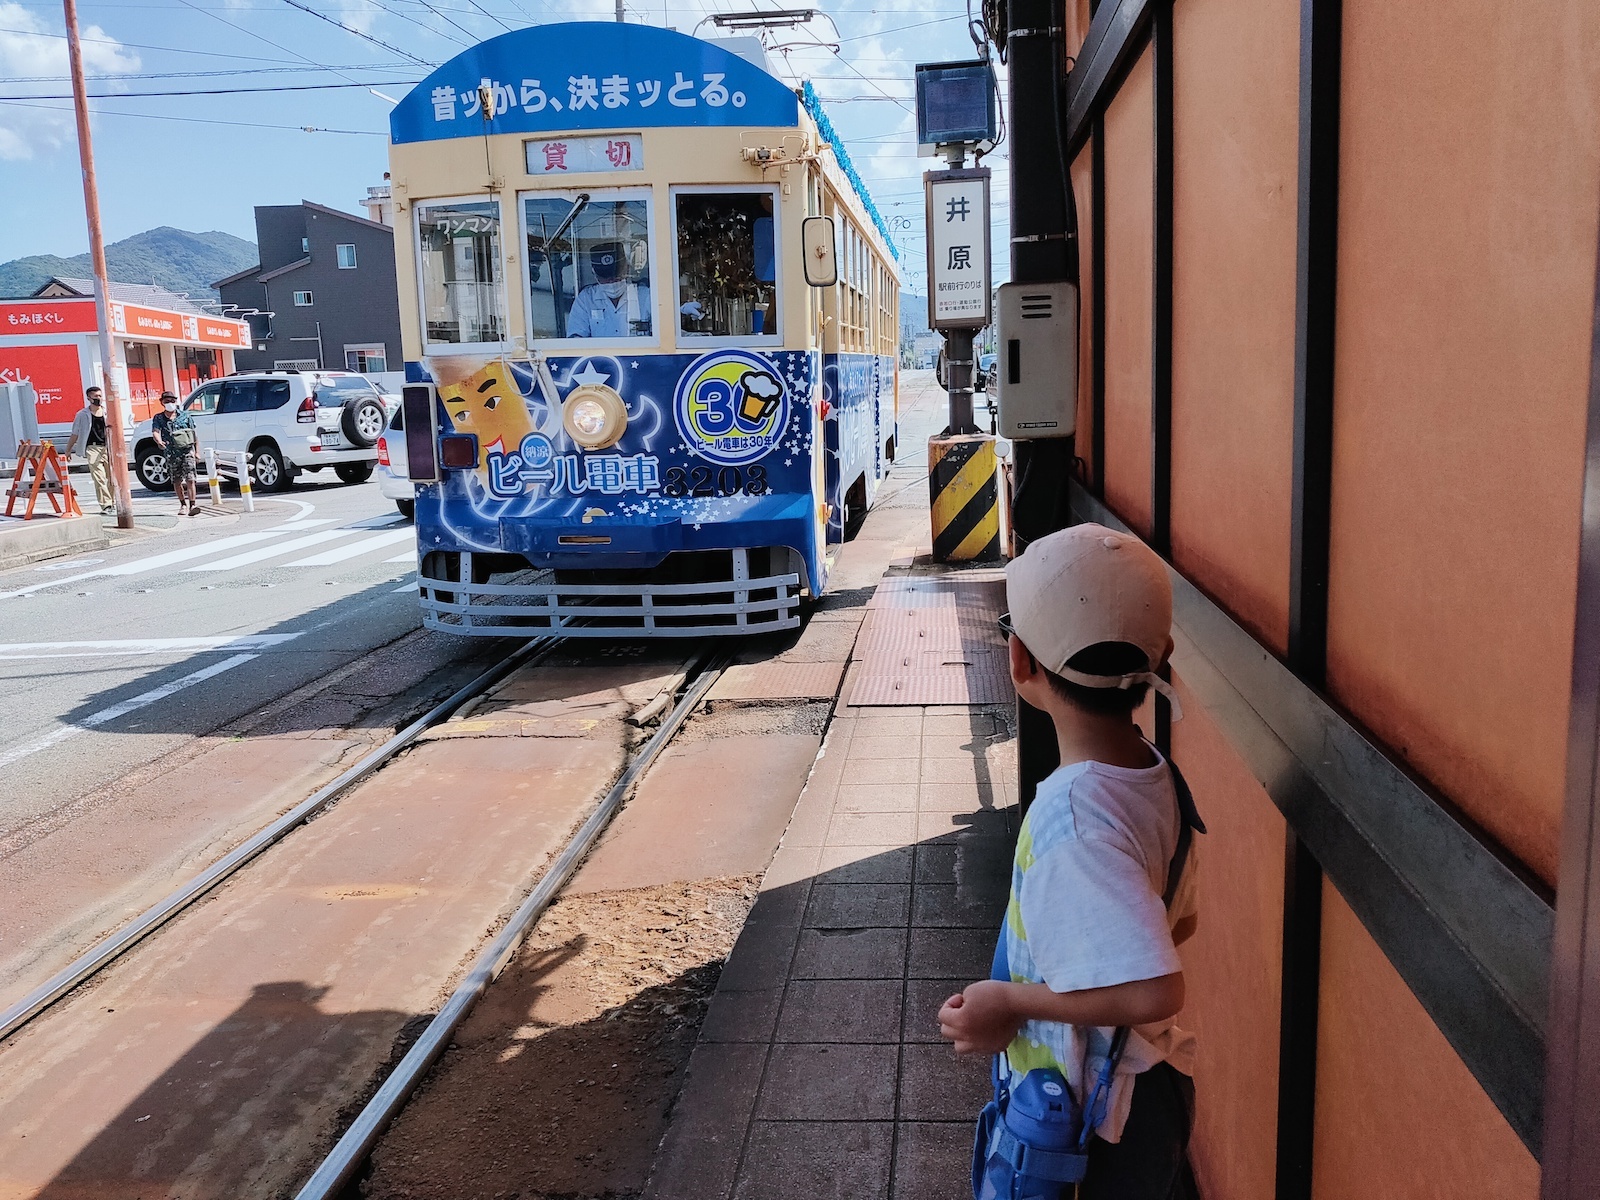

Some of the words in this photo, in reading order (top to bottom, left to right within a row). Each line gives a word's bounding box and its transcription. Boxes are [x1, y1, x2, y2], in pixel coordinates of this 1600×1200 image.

[431, 72, 747, 122] 昔ッから、決まッとる。
[542, 140, 632, 171] 貸切
[437, 218, 493, 235] ワンマン
[946, 196, 972, 271] 井原
[938, 280, 982, 291] 駅前行のりば
[8, 313, 64, 325] もみほぐし
[524, 445, 549, 458] 納涼
[697, 435, 773, 451] ビール電車は30年
[490, 453, 661, 494] ビール電車
[665, 464, 768, 498] 3203
